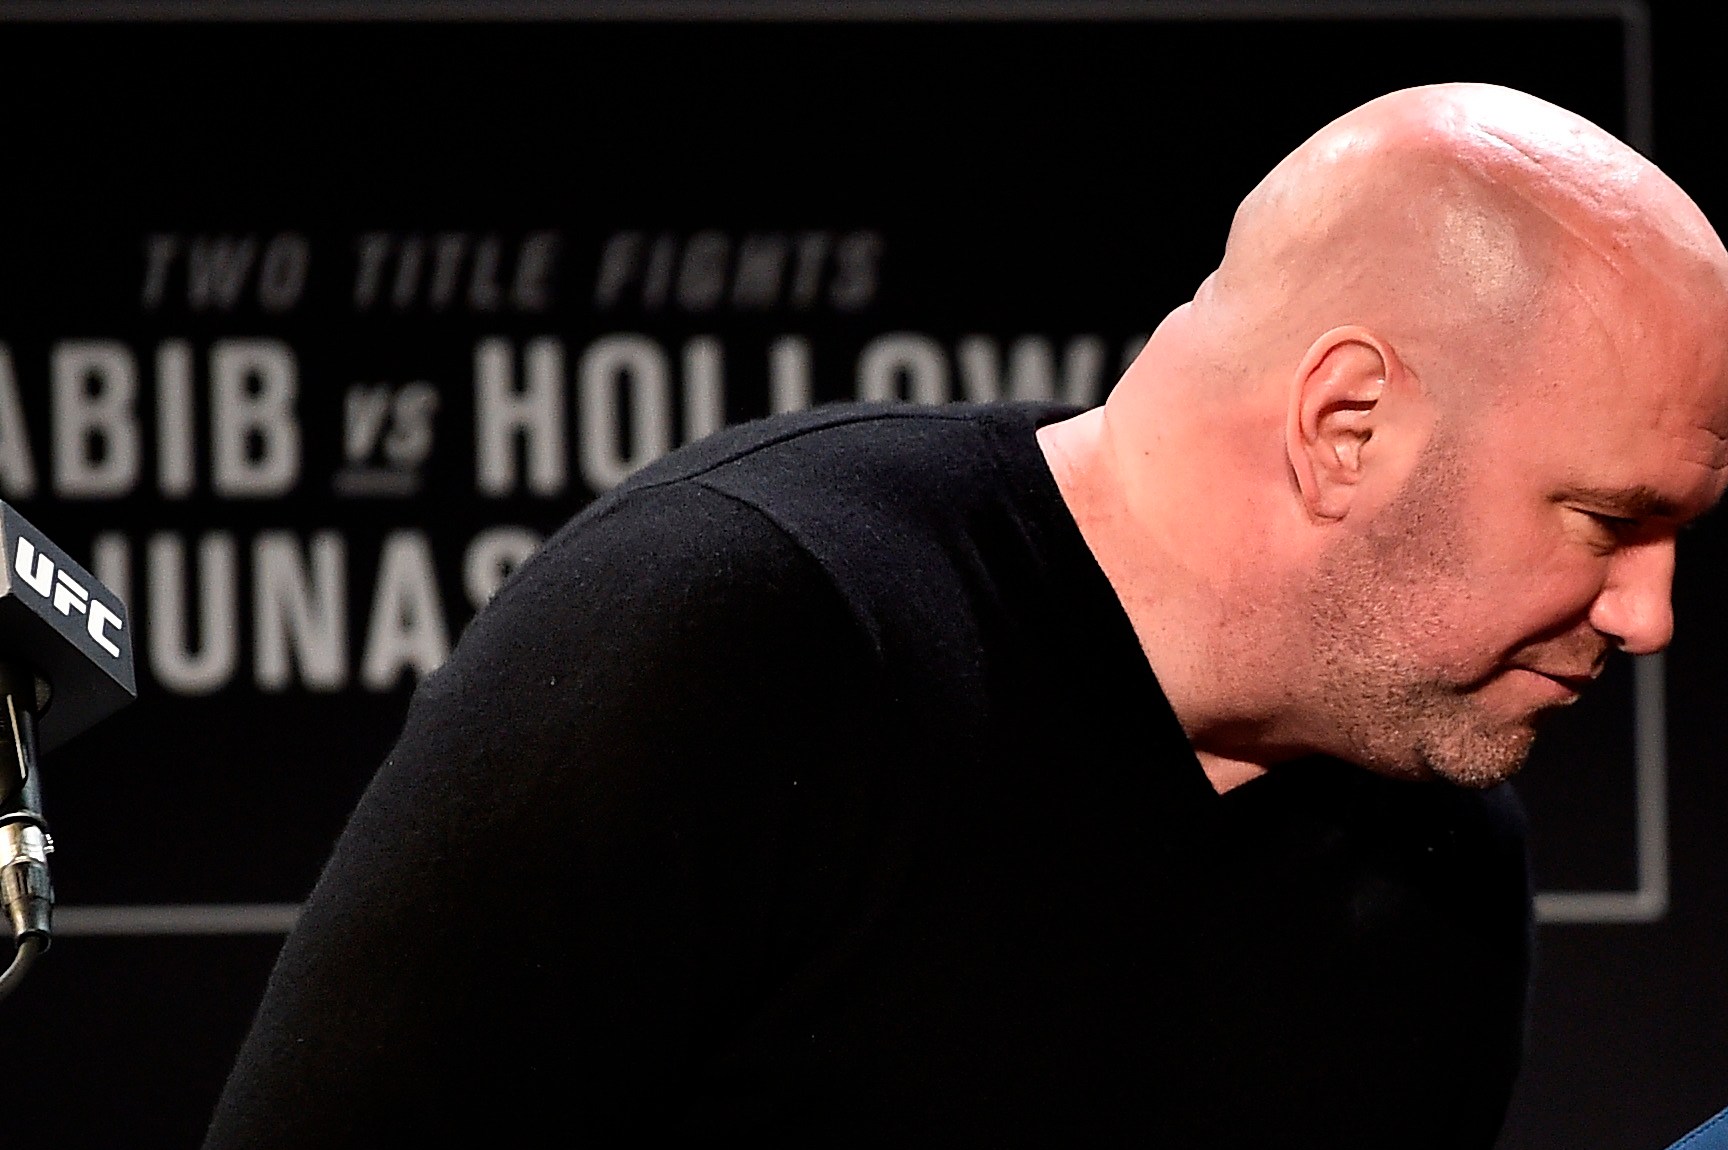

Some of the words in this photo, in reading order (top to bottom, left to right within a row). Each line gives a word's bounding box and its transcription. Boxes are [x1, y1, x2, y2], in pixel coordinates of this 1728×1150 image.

[142, 232, 311, 313] TWO
[352, 230, 563, 313] TITLE
[594, 229, 886, 313] FIGHTS
[14, 536, 123, 658] UFC
